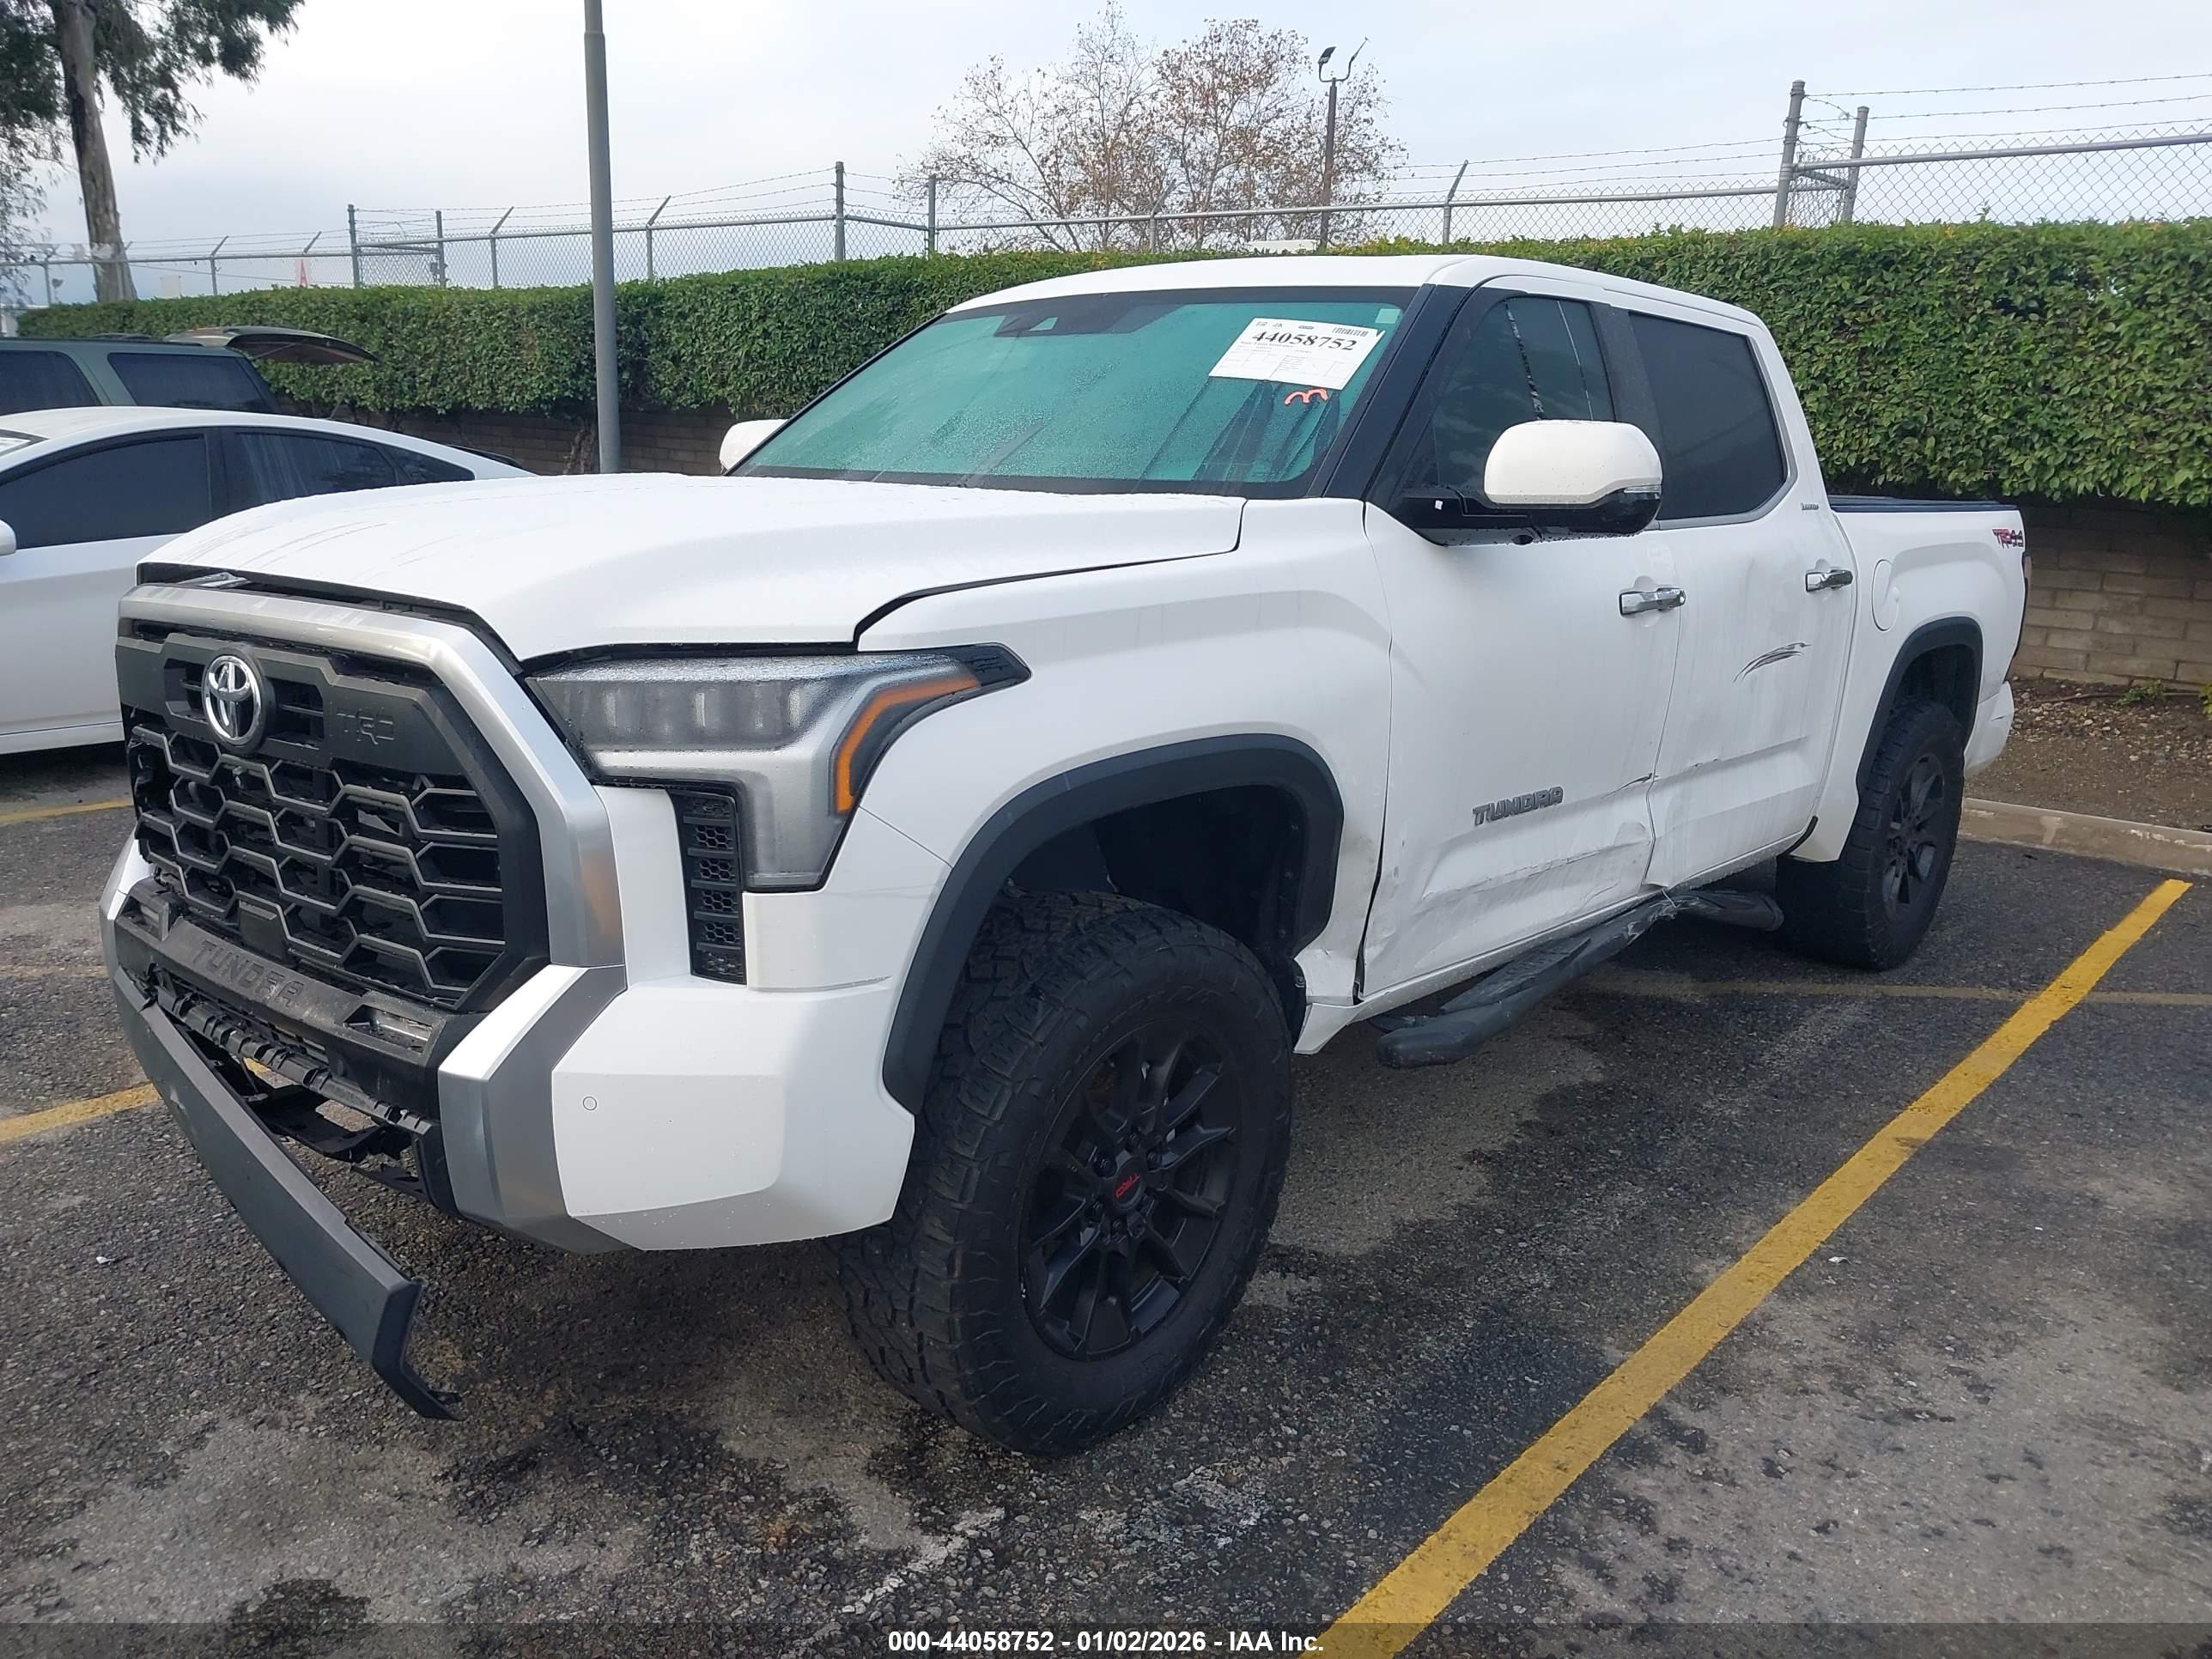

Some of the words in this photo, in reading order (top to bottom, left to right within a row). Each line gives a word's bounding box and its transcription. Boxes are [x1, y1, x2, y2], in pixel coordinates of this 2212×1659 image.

[1252, 331, 1357, 351] 44058752
[336, 707, 395, 745] TRD
[1472, 785, 1565, 826] TUNDRA
[192, 939, 306, 1008] TUNDRA
